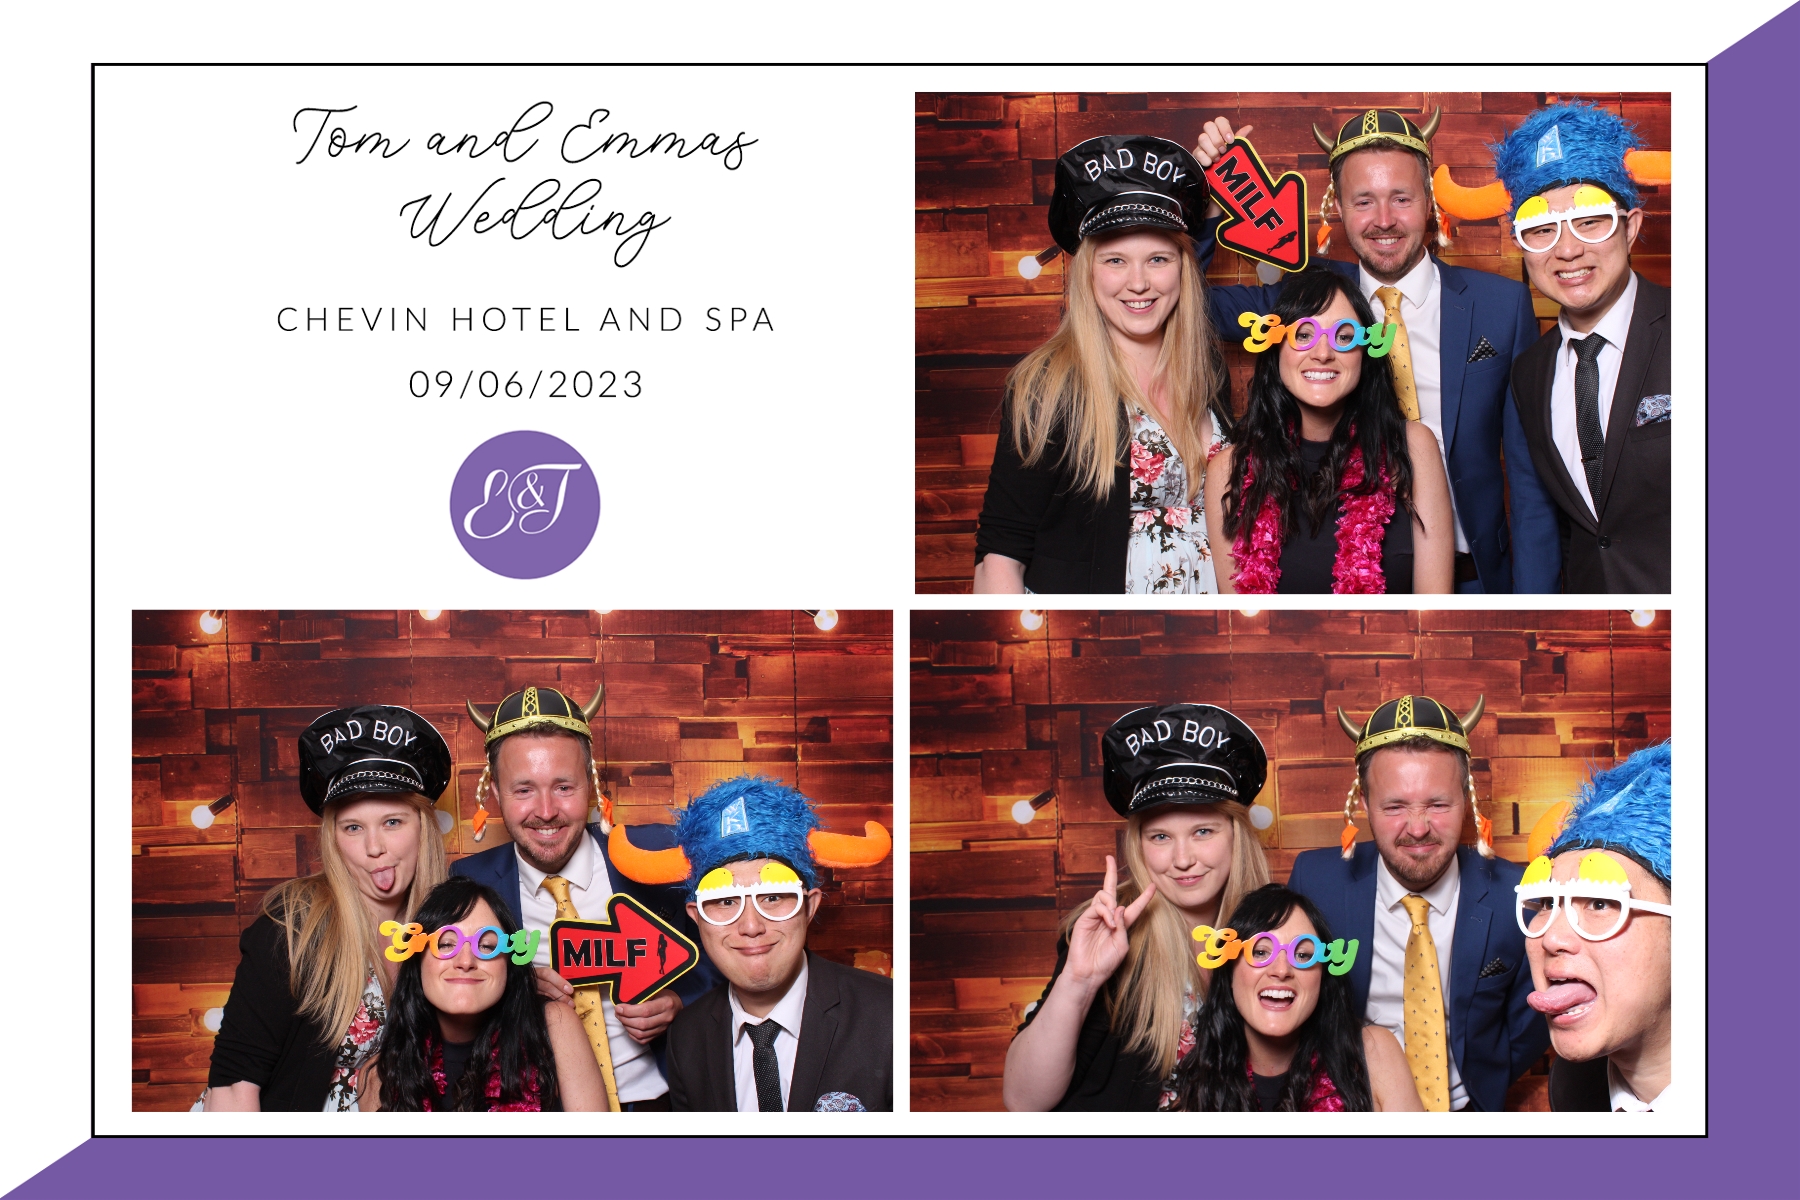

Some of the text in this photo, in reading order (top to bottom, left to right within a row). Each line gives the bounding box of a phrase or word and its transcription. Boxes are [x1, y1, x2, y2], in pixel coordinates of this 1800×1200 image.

[1085, 148, 1187, 184] BAD BOY
[1214, 155, 1284, 231] MILF
[320, 720, 418, 754] BAD BOY
[1125, 719, 1232, 756] BAD BOY
[562, 937, 647, 968] MILF
